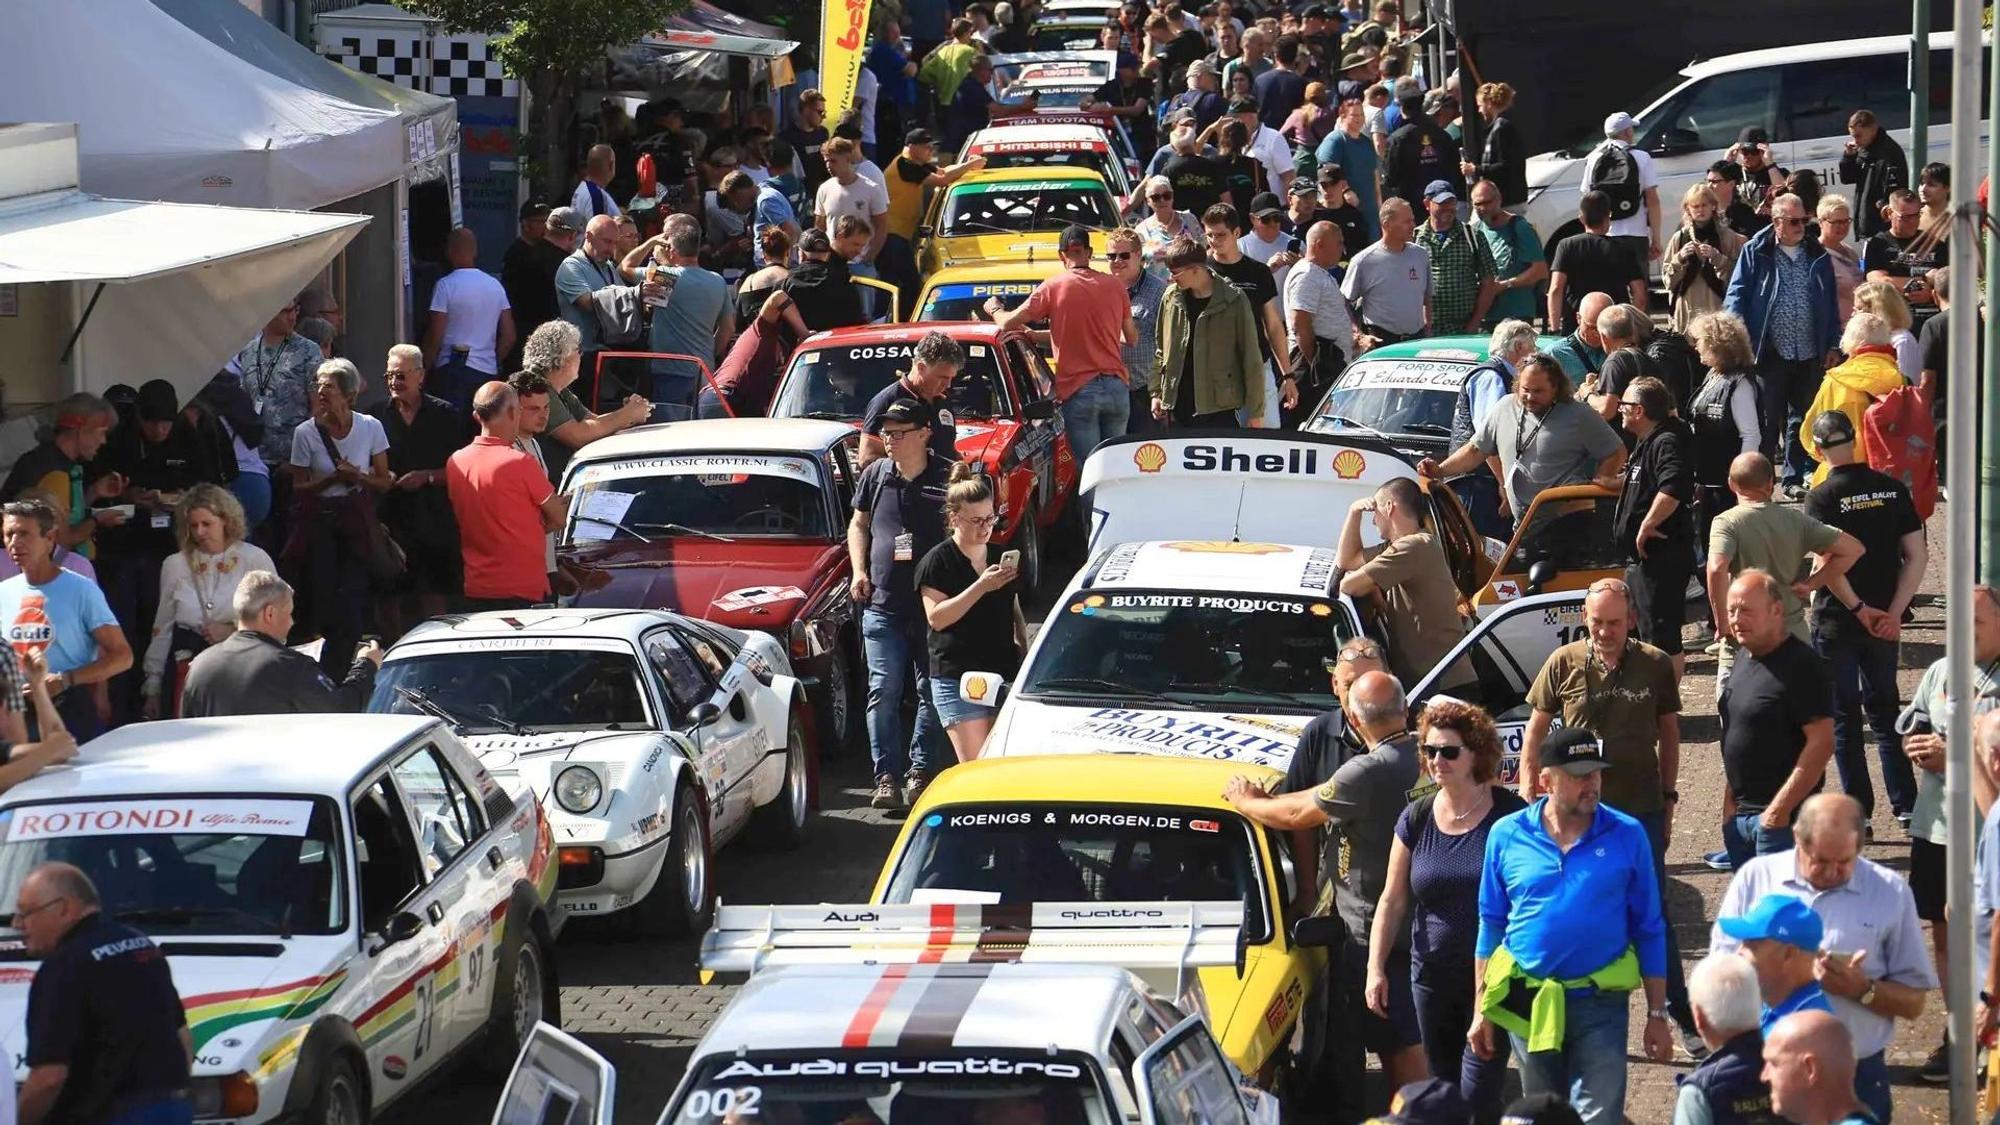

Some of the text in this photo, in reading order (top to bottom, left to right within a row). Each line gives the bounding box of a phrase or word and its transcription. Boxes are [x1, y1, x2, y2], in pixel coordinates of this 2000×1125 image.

[1008, 117, 1037, 127] TEAM
[1041, 116, 1087, 125] TOYOTA
[1000, 142, 1077, 151] MITSUBISHI
[973, 284, 1037, 296] PIERB
[1396, 363, 1434, 371] FORD
[1370, 371, 1428, 385] Eduardo
[613, 458, 771, 472] WWW.CLASSIC-ROVER.NL
[1183, 444, 1317, 475] Shell
[1851, 493, 1871, 503] EIFEL
[1852, 499, 1885, 511] FESTIVAL
[1111, 594, 1305, 614] BUYRITE PRODUCTS
[10, 626, 51, 640] Gulf
[1089, 708, 1297, 758] BUYRITE
[1093, 722, 1242, 760] PRODUCTS
[19, 808, 194, 836] ROTONDI
[950, 812, 1182, 829] KOENIGS & MORGEN.DE
[823, 910, 880, 922] Audi
[1061, 908, 1164, 920] quattro
[467, 943, 484, 995] 97
[413, 979, 434, 1062] 21
[713, 1057, 1081, 1081] Audi quattro
[686, 1085, 762, 1119] 002
